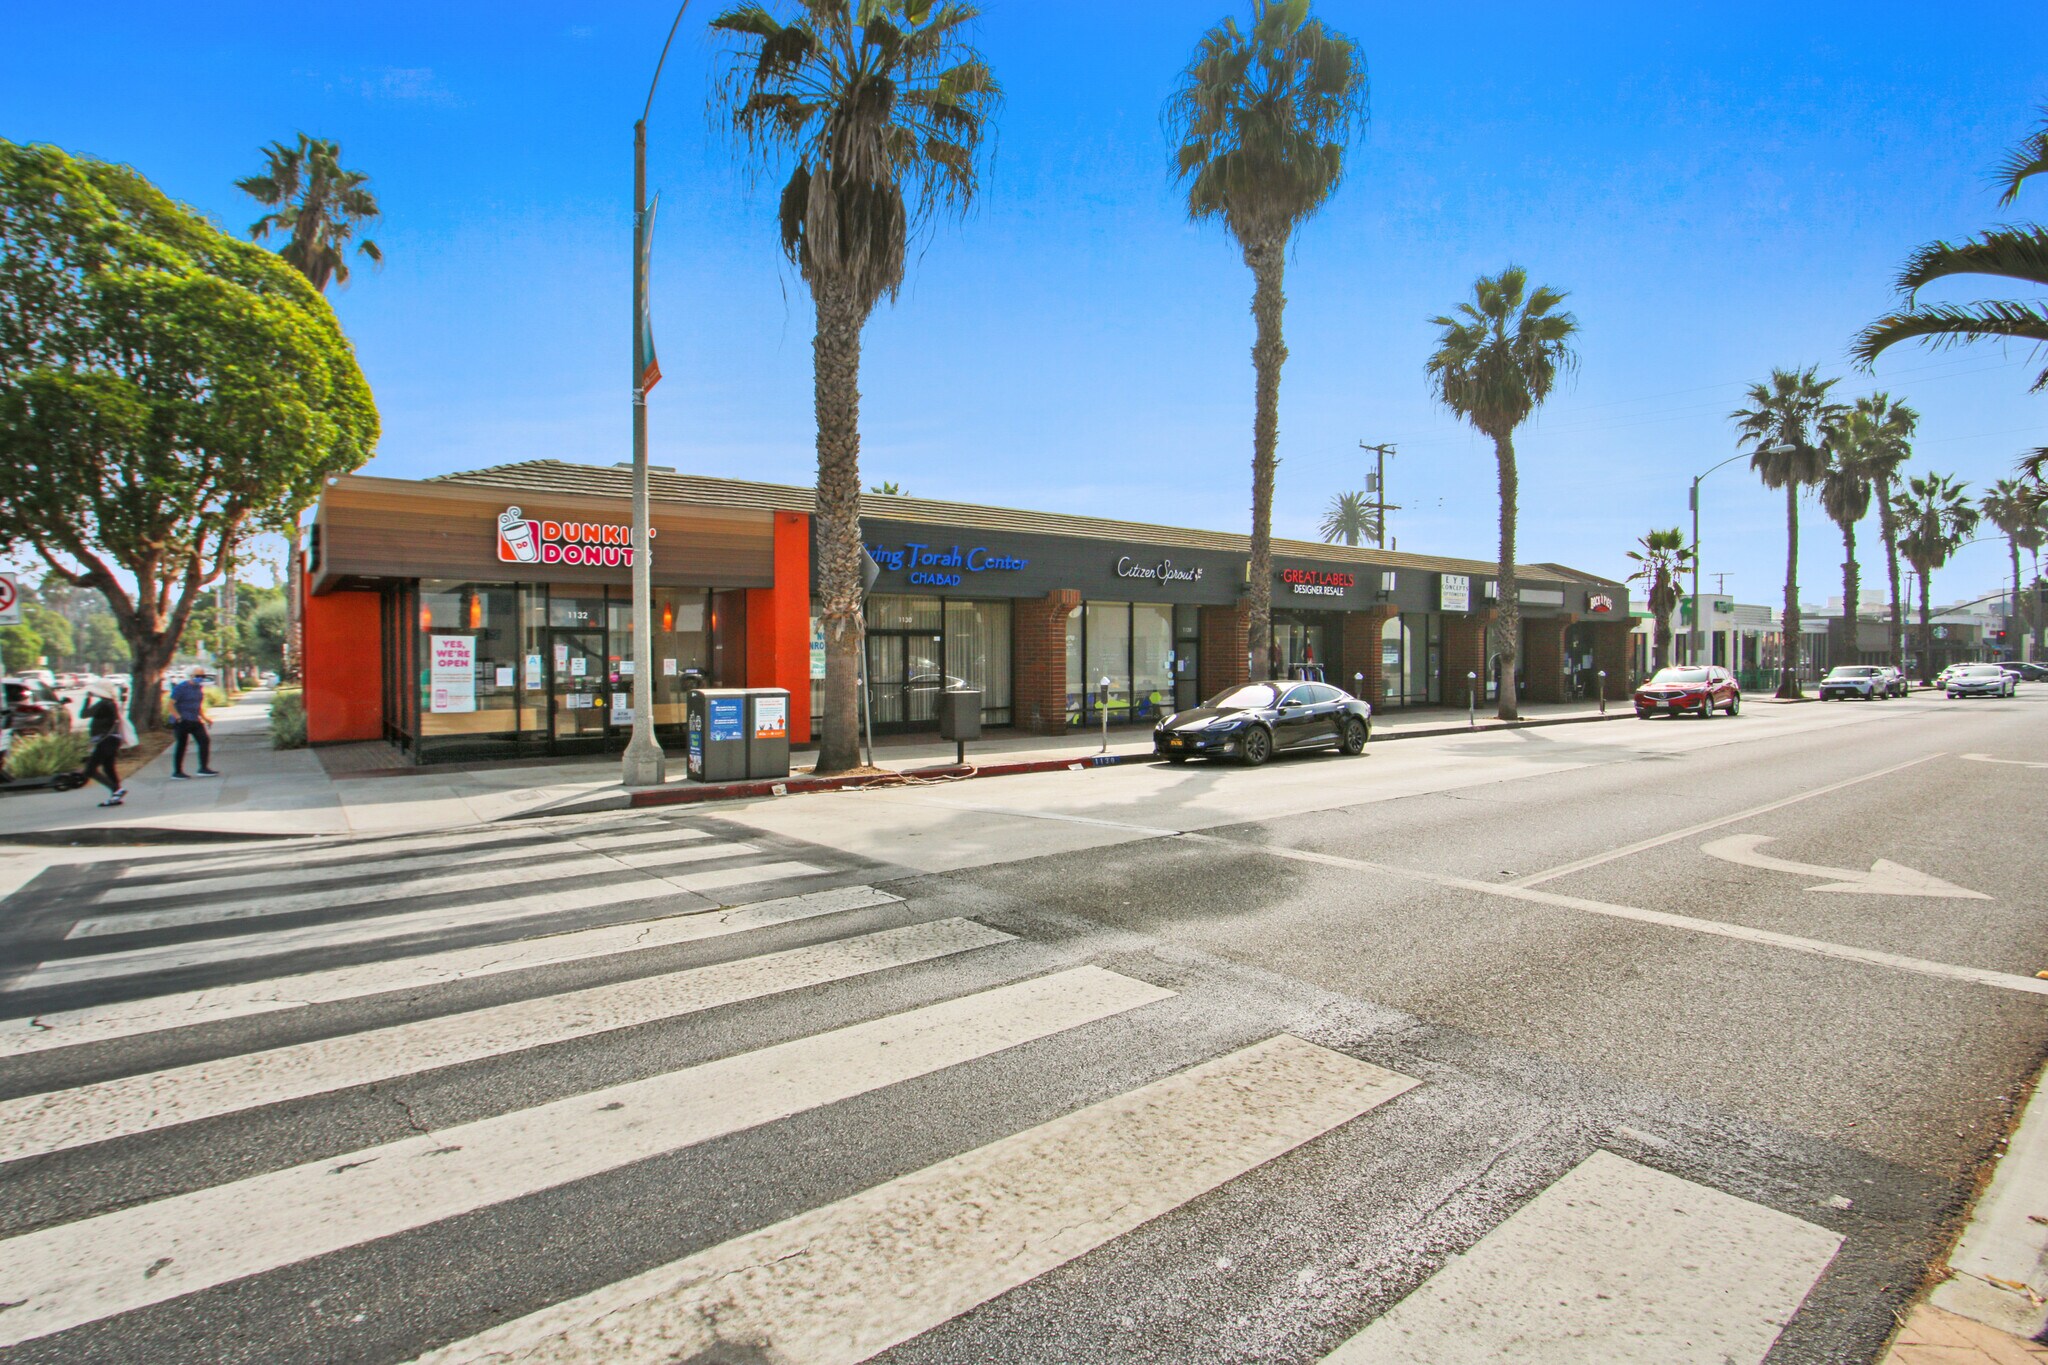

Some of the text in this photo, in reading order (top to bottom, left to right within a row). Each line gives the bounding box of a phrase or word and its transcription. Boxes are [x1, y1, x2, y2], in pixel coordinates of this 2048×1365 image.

[542, 521, 657, 546] DUNKI'
[516, 541, 528, 549] DD
[542, 543, 653, 567] DONUT
[905, 543, 962, 568] Torah
[967, 547, 1029, 571] Center
[1117, 556, 1195, 586] Citizen Sprout
[910, 571, 961, 586] CHABAD
[1283, 568, 1355, 587] GREAT LABELS
[1445, 575, 1465, 585] EYE
[1294, 584, 1344, 596] DESIGNER RESALE
[1441, 584, 1469, 592] CONCEPTS
[567, 611, 589, 620] 1132
[442, 640, 466, 649] YES,
[436, 650, 470, 658] WE'RE
[438, 659, 469, 668] OPEN
[529, 656, 537, 665] A
[1095, 757, 1115, 765] 1130
